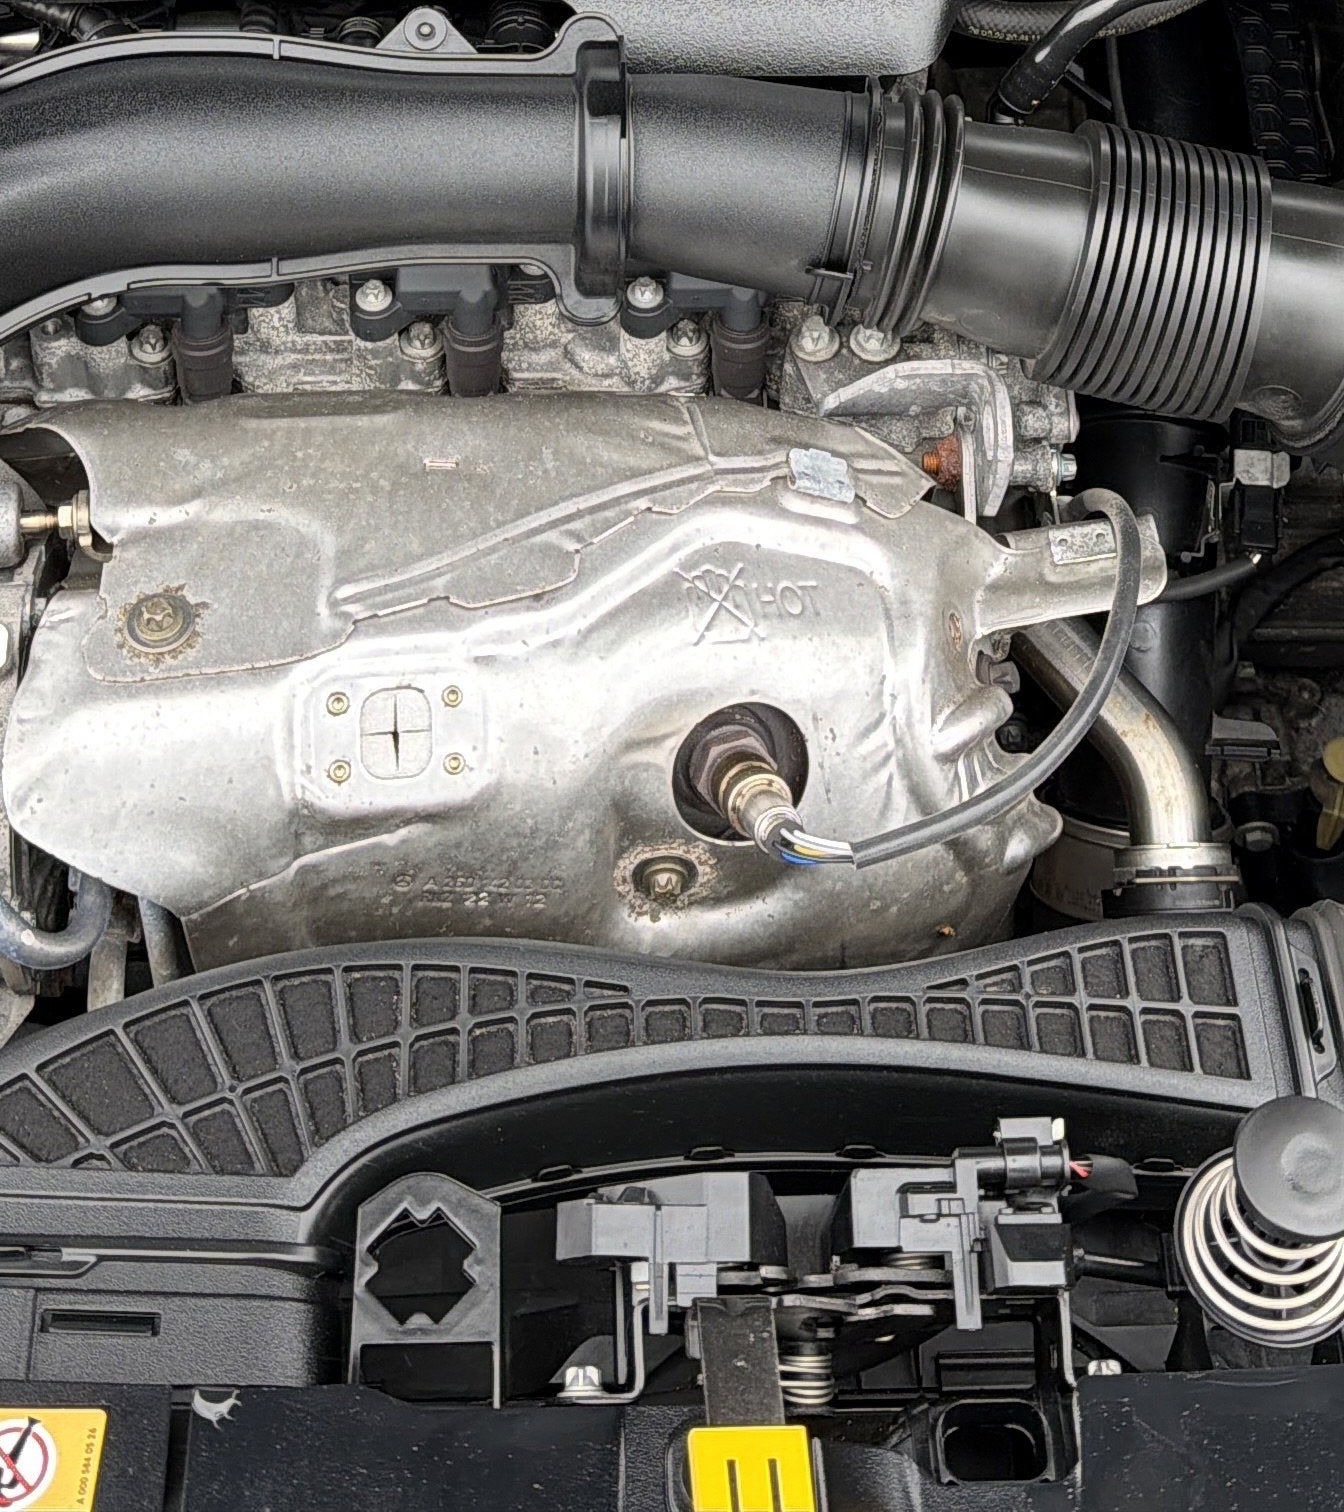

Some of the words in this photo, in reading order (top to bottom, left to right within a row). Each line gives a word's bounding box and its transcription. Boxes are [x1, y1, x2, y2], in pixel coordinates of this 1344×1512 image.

[462, 891, 490, 907] 22
[86, 1427, 98, 1440] 26
[84, 1442, 95, 1455] 05
[81, 1456, 92, 1475] 584
[77, 1476, 89, 1496] 000
[76, 1497, 85, 1505] A
